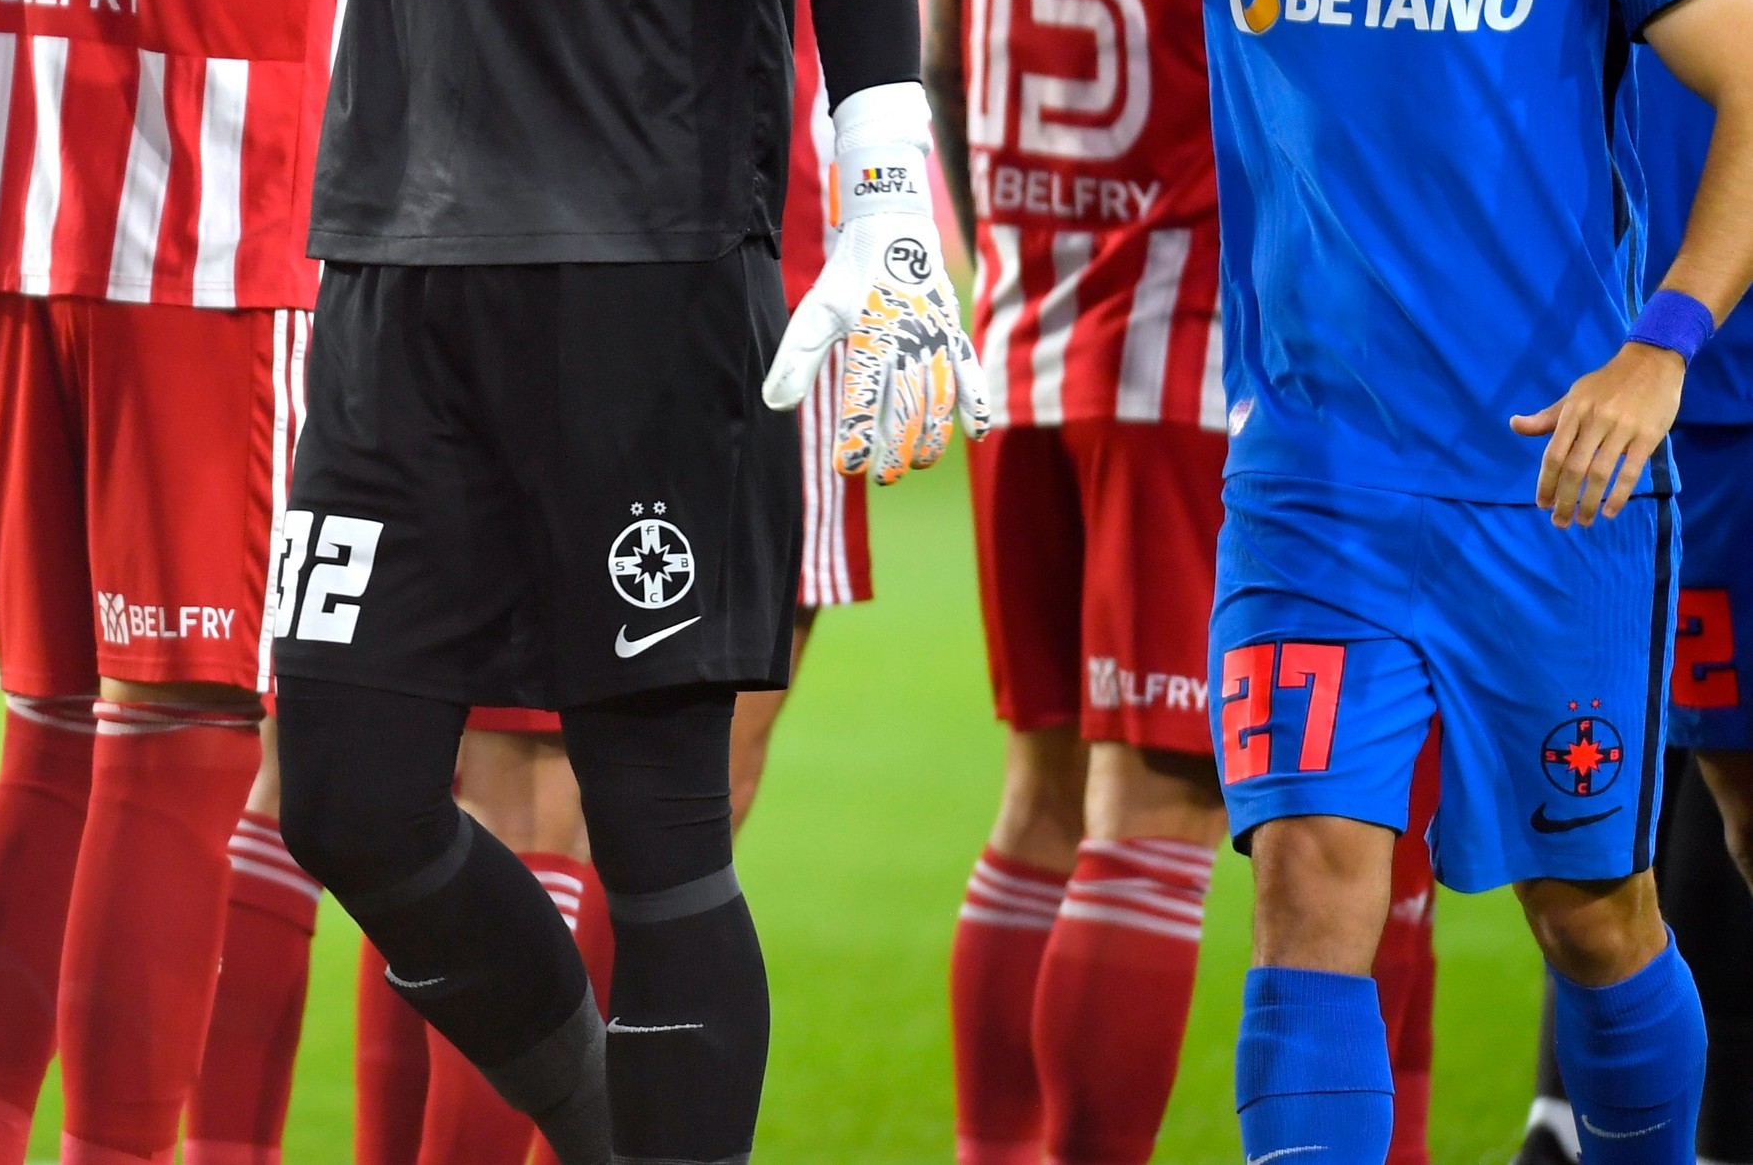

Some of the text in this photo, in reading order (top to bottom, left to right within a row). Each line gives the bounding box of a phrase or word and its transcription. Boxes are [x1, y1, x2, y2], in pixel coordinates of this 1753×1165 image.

[992, 166, 1160, 222] BELFRY
[129, 604, 236, 640] BELFRY
[1119, 670, 1208, 712] LFRY
[1222, 641, 1345, 784] 27
